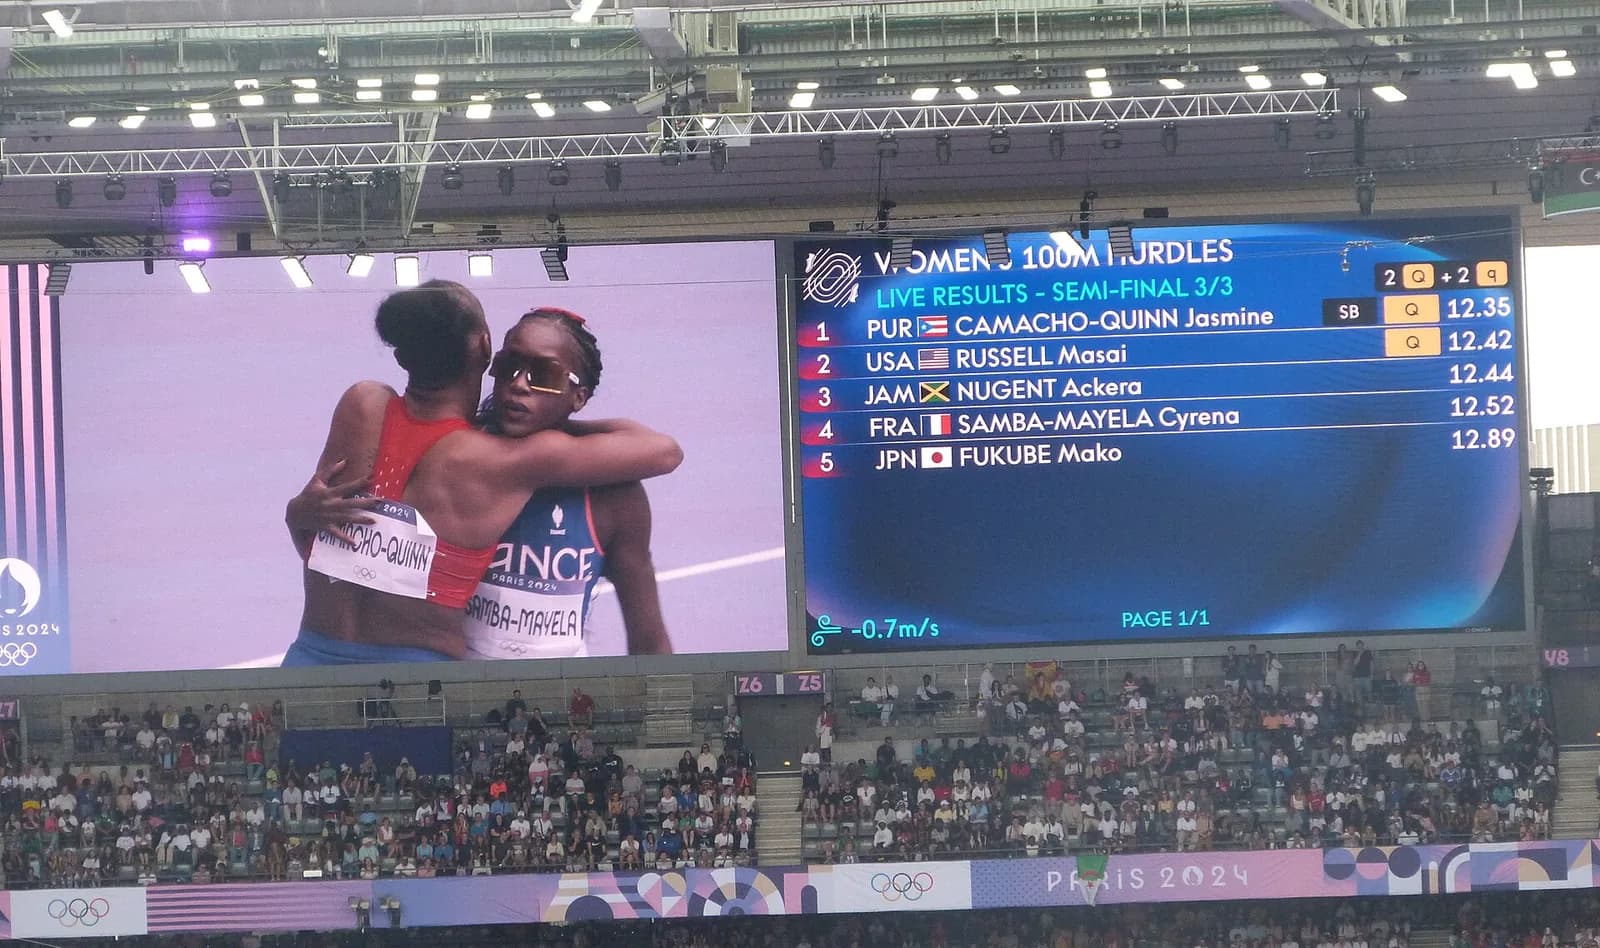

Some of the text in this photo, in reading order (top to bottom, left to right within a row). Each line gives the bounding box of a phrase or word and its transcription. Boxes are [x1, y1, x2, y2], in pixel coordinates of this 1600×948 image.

[874, 247, 1012, 275] WOMEN
[1023, 244, 1099, 269] 100M
[1384, 267, 1497, 286] 2 Q + 2 q
[877, 288, 925, 308] LIVE
[933, 284, 1028, 306] RESULTS
[1052, 278, 1189, 301] SEMI-FINAL
[1195, 276, 1233, 297] 3/3
[816, 296, 1511, 341] 1 PUR CAMACHO-QUINN Jasmine SB Q 12.35
[816, 329, 1512, 374] 2 USA RUSSELL Masai Q 12.42
[818, 362, 1514, 406] 3 JAM NUGENT Ackera 12.44
[818, 395, 1515, 439] 4 FRA SAMBA-MAYELA Cyrena 12.52
[820, 428, 1516, 472] 5 JPN FUKUBE Mako 12.89
[384, 504, 409, 519] 2024
[318, 521, 431, 572] CACHO-QUINN
[492, 573, 557, 592] PARIS 2024
[465, 594, 577, 638] SAMBA-MAYELA
[852, 617, 940, 640] -0.7m/s
[1122, 609, 1210, 628] PAGE 1/1
[16, 624, 59, 636] 2024
[739, 677, 763, 693] Z6
[799, 675, 822, 692] Z5
[1160, 865, 1248, 888] 2024
